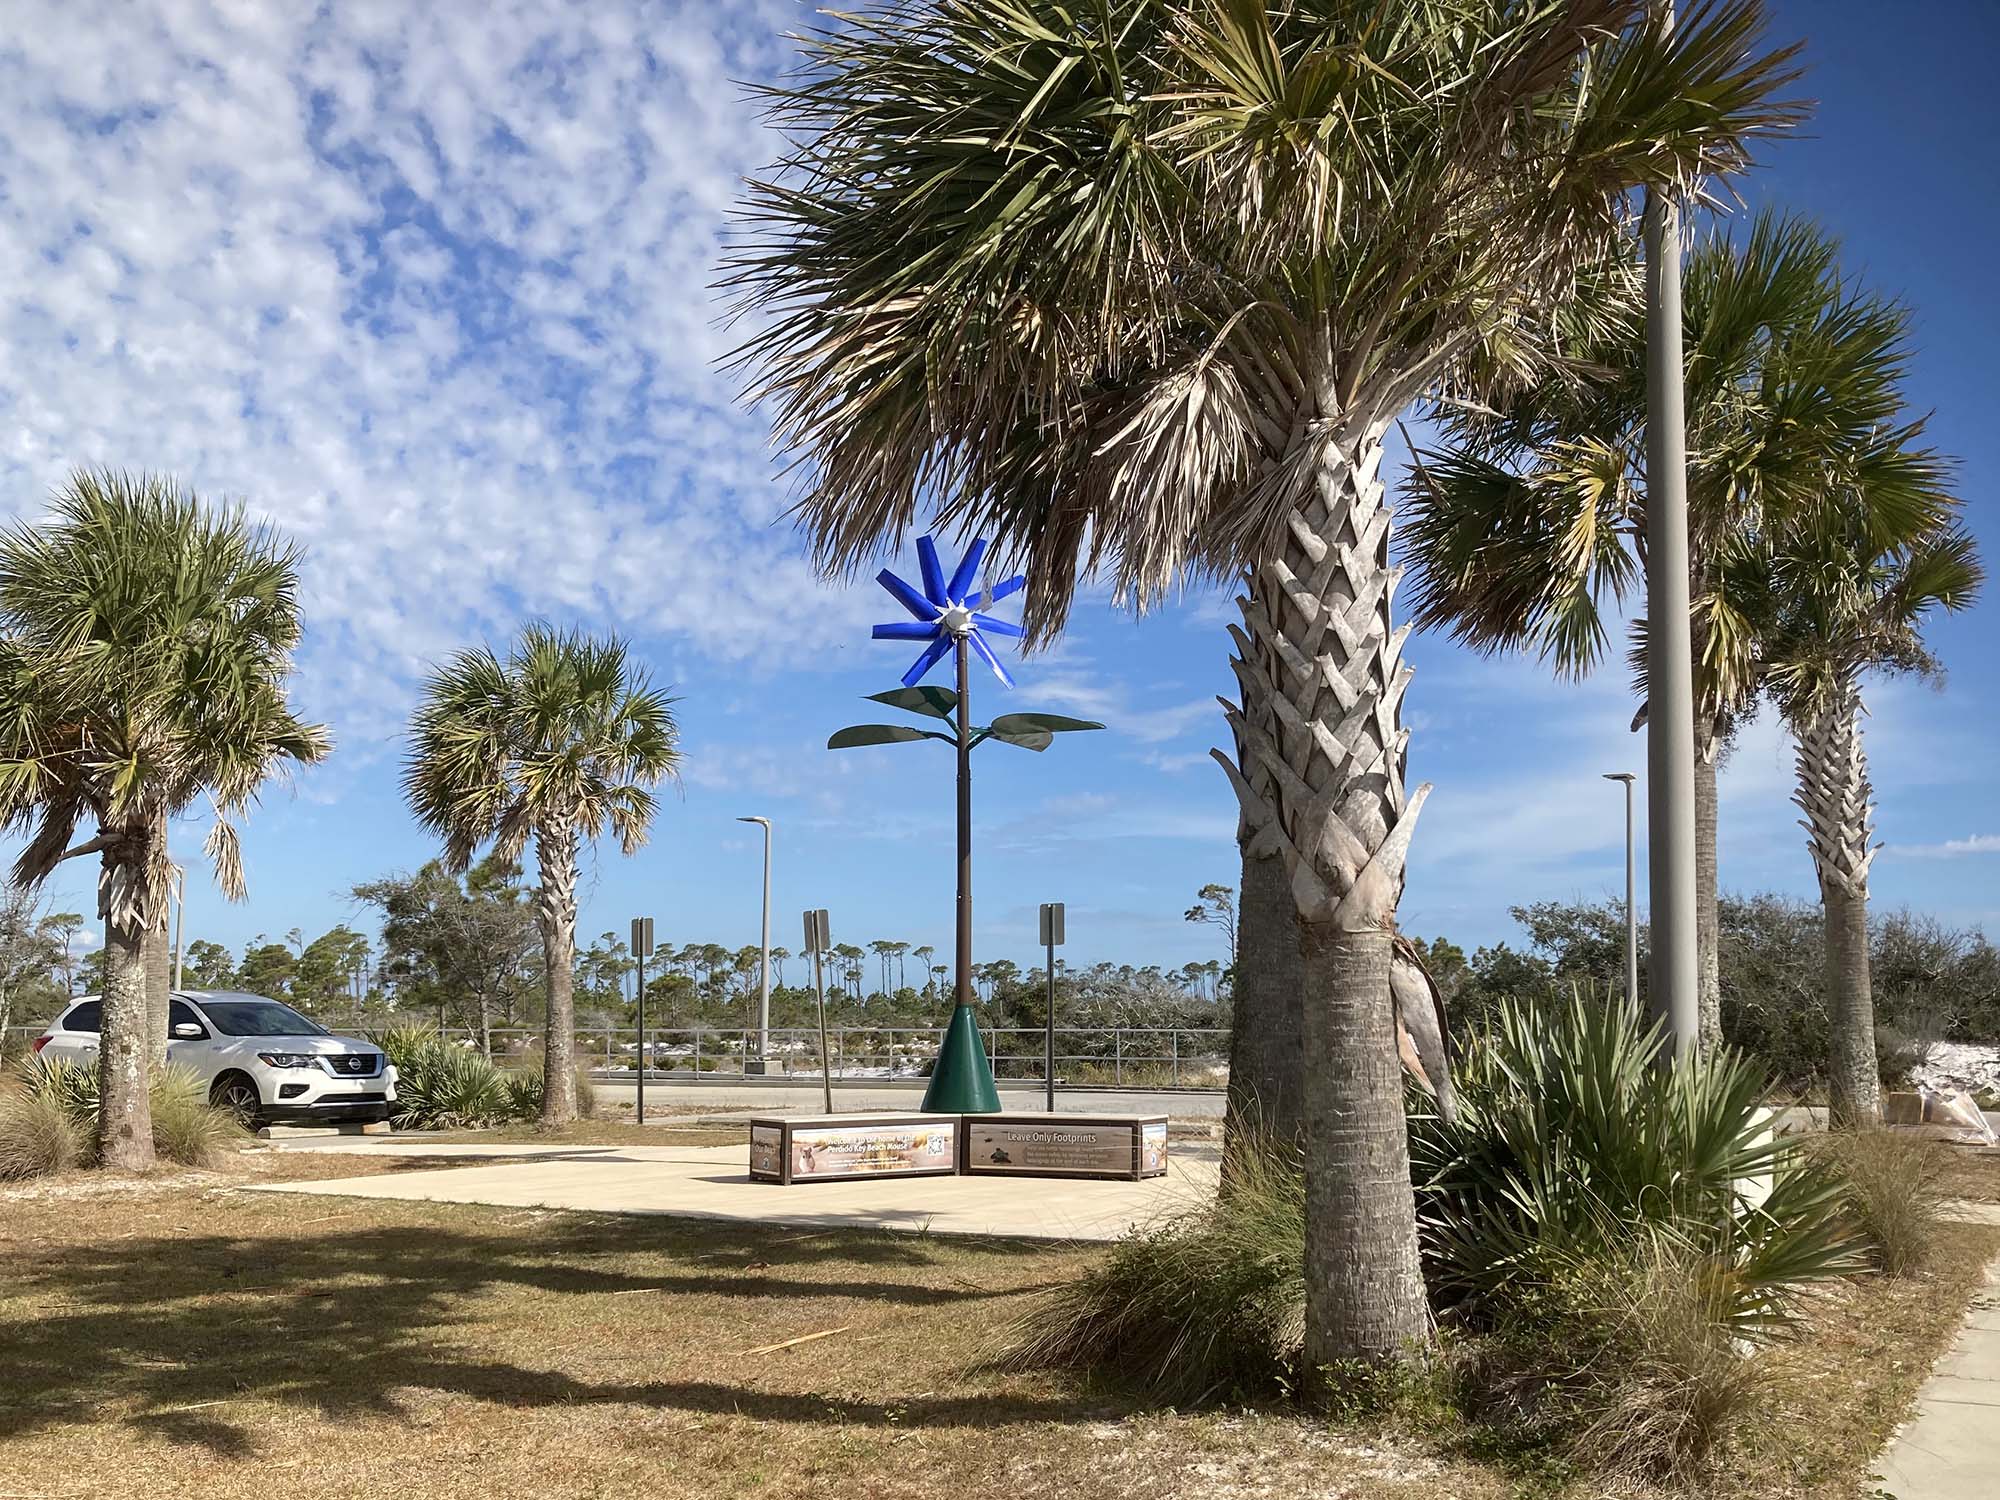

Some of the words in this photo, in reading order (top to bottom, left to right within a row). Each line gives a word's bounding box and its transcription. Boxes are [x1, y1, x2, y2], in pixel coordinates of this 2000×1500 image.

[1007, 1132, 1031, 1142] Leave
[1032, 1132, 1052, 1143] Only
[1053, 1132, 1097, 1144] Footprints
[828, 1145, 853, 1153] Perdido
[854, 1144, 866, 1153] Key
[867, 1143, 887, 1151] Beach
[887, 1143, 908, 1151] Mouse
